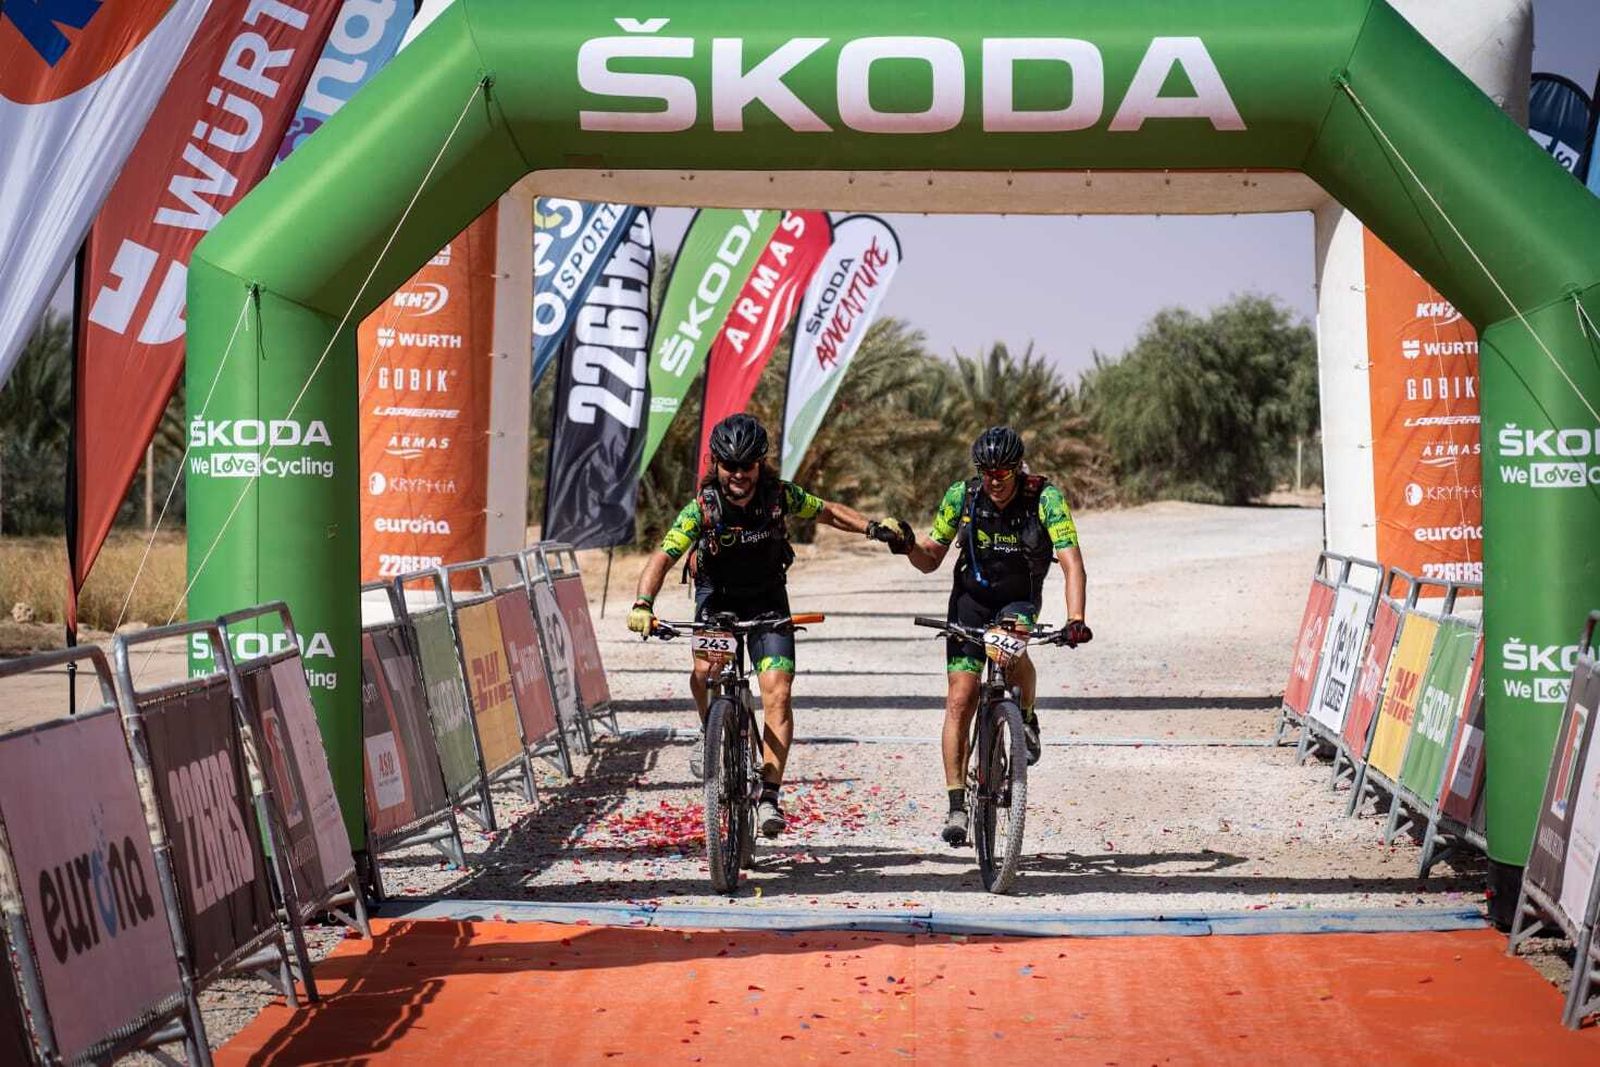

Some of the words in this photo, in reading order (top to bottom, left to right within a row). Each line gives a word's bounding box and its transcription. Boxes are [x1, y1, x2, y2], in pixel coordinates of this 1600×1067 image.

[577, 17, 1247, 133] ŠKODA
[725, 210, 806, 354] ARMAS
[806, 257, 855, 336] ŠKODA
[816, 235, 889, 370] ADVENTURE
[399, 333, 462, 348] WÜRTH
[378, 367, 448, 393] GOBIK
[1407, 376, 1475, 400] GOBIK
[189, 415, 332, 447] ŠKODA
[1404, 415, 1481, 427] LAPIERR
[388, 436, 450, 449] ARMAS
[1422, 443, 1481, 456] ARMAS
[1499, 423, 1600, 456] ŠKO
[190, 457, 209, 474] We
[214, 455, 256, 474] Love
[262, 457, 334, 478] Cycling
[1500, 465, 1528, 484] We
[1534, 465, 1581, 483] Love
[699, 638, 730, 650] 243
[990, 635, 1025, 653] 244
[1503, 636, 1600, 671] ŠKO
[1503, 679, 1532, 698] We
